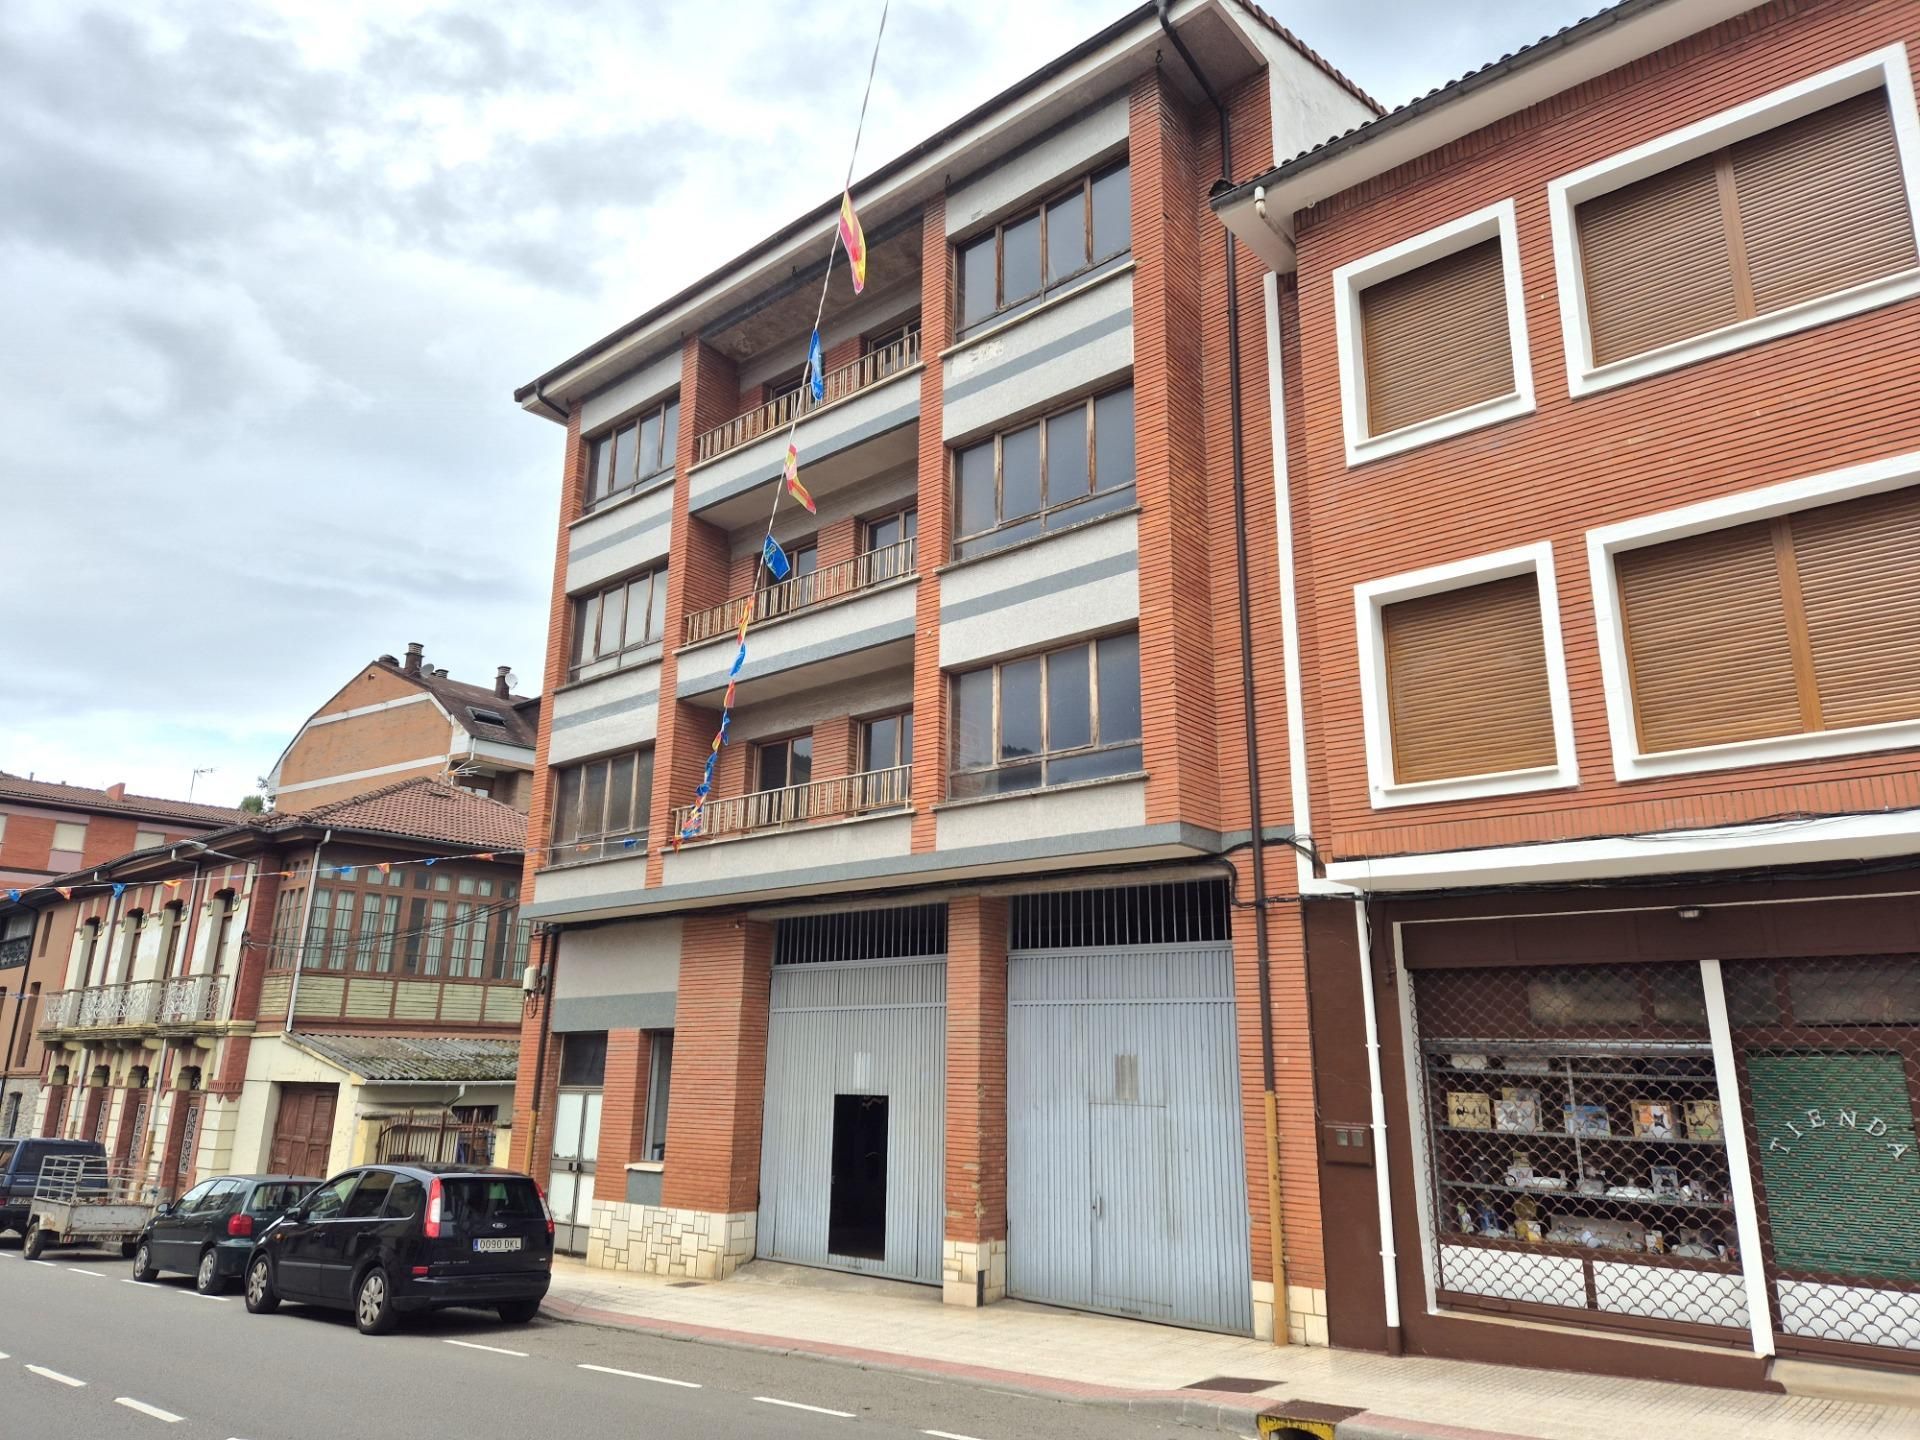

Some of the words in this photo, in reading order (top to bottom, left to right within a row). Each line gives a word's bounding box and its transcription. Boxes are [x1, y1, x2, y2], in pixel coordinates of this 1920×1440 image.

[1769, 1108, 1909, 1160] TIENDA
[480, 1239, 502, 1249] 0090
[504, 1239, 520, 1249] DKL
